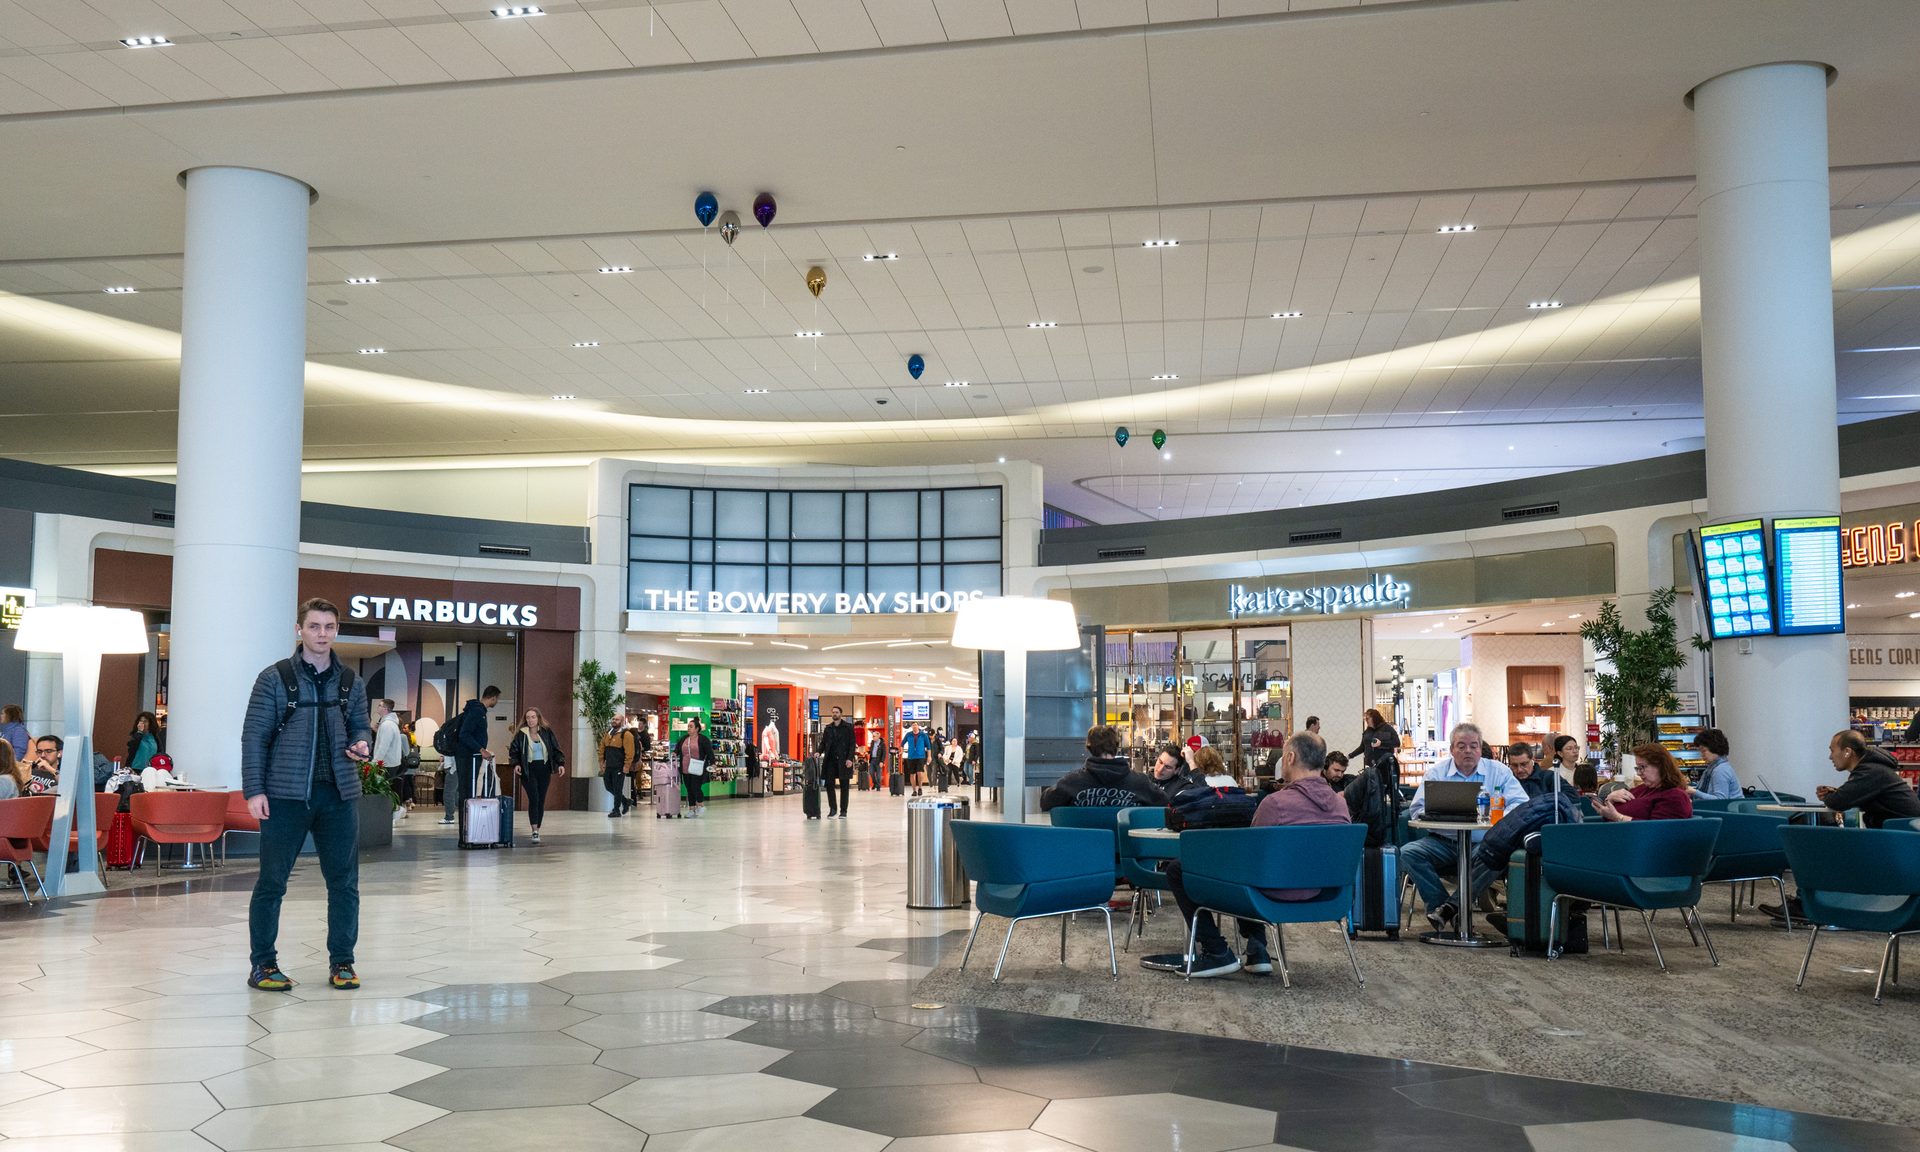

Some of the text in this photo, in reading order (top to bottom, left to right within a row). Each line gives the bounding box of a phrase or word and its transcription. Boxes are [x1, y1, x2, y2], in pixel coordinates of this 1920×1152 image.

[645, 589, 699, 611] THE
[708, 591, 827, 614] BOWERY
[835, 592, 886, 614] BAY
[1228, 573, 1399, 614] kate spade
[350, 595, 538, 627] STARBUCKS
[1076, 787, 1137, 801] CHOOSE
